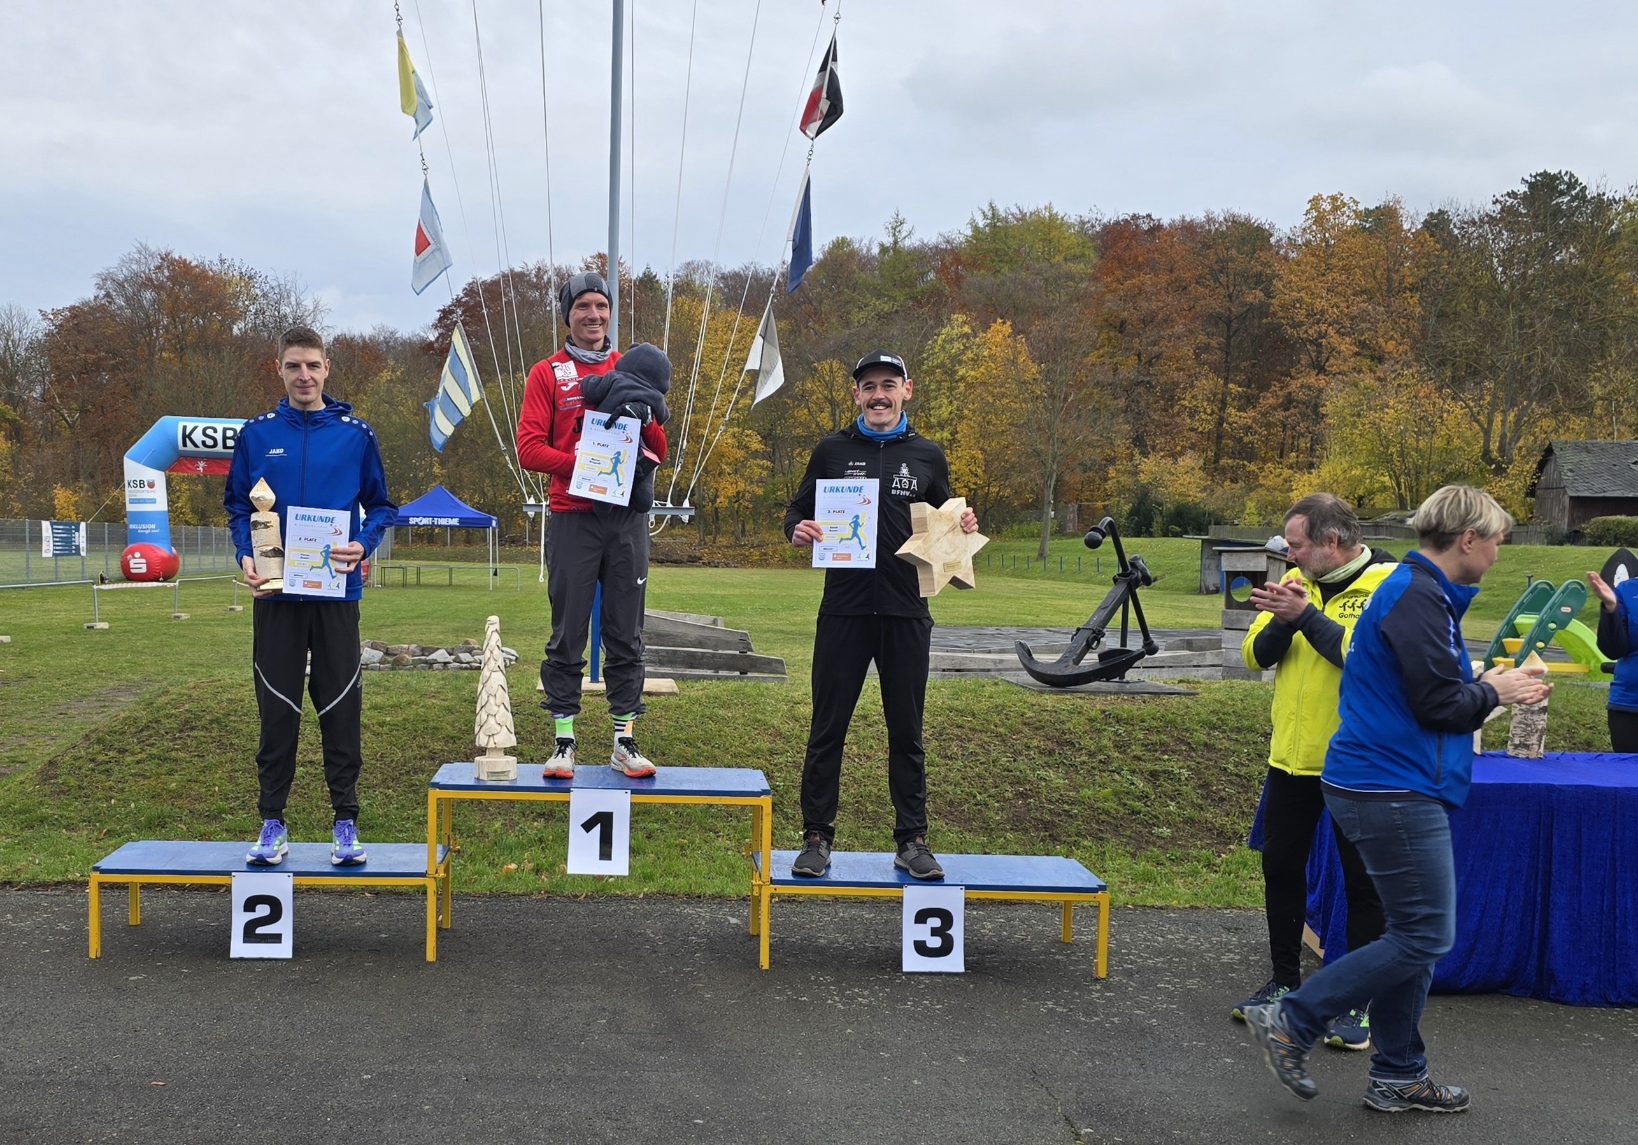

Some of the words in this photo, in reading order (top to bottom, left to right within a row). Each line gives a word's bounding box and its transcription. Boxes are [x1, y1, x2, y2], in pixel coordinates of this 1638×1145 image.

[591, 418, 629, 431] URNDE
[181, 424, 238, 449] KSB
[127, 479, 146, 489] KSB
[823, 485, 864, 494] URKUNDE
[294, 513, 337, 524] URKUNDE
[408, 517, 460, 526] SPORT-THIEME
[580, 811, 614, 861] 1
[242, 894, 283, 944] 2
[913, 907, 955, 958] 3
